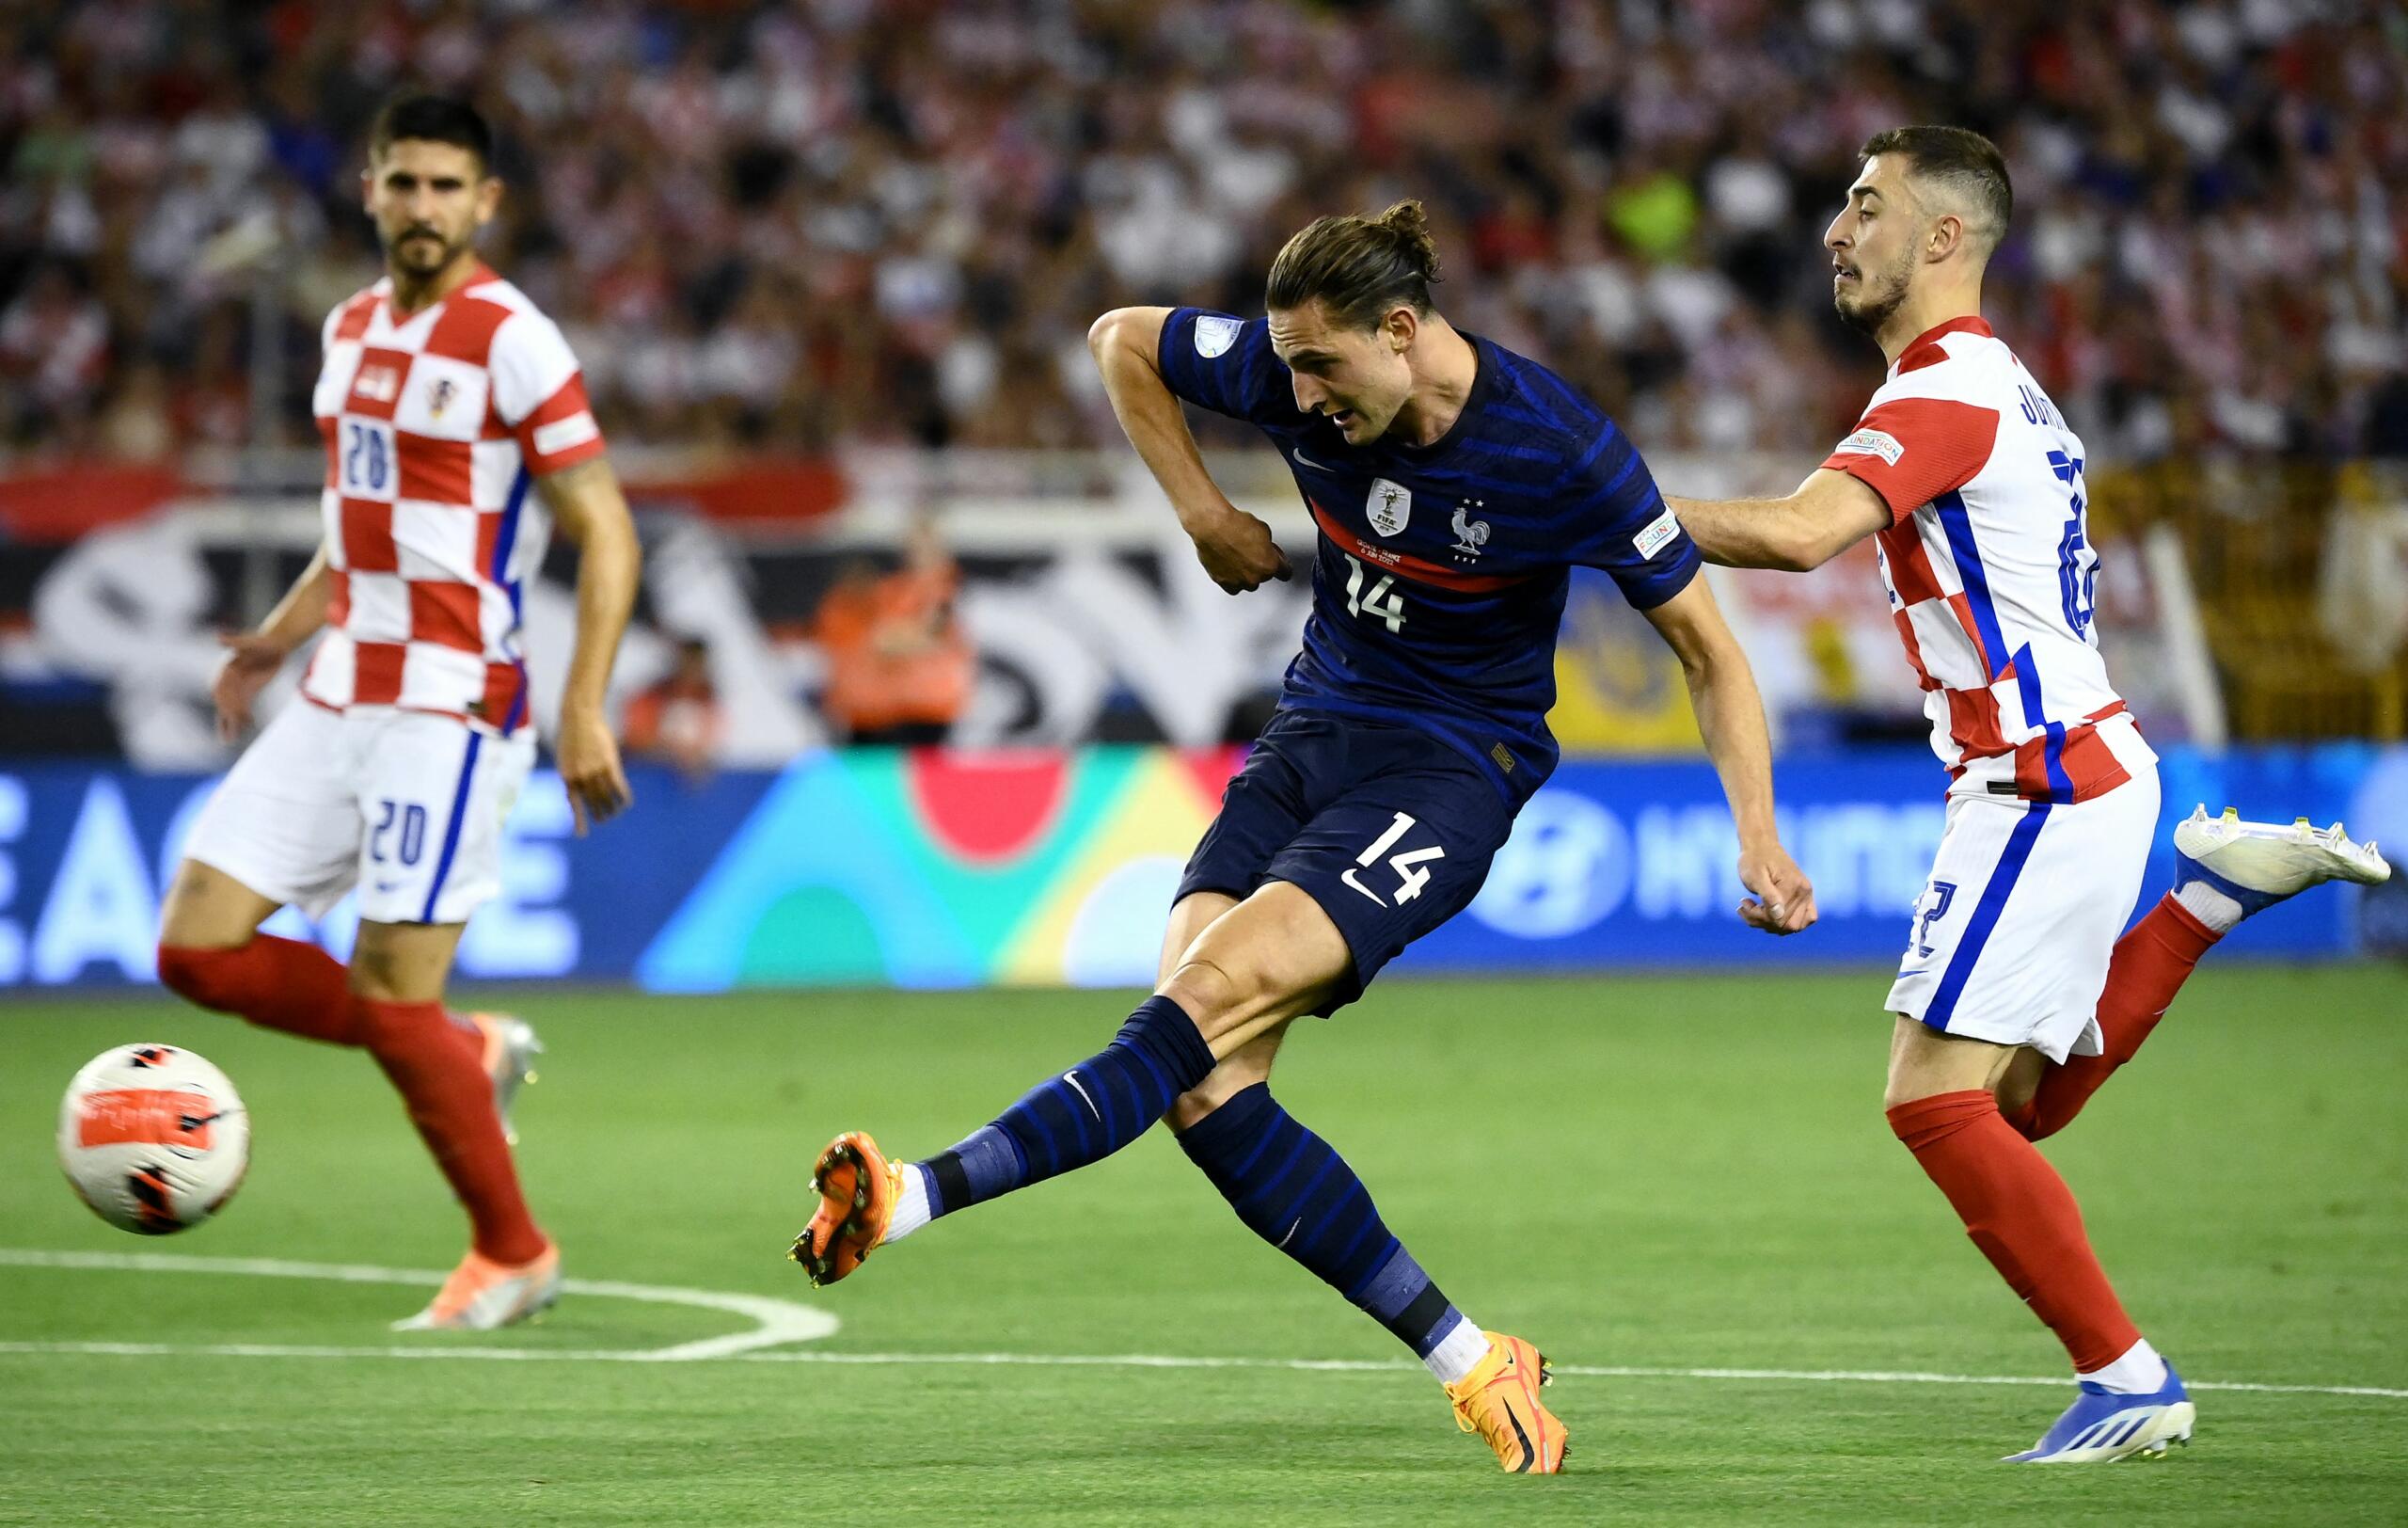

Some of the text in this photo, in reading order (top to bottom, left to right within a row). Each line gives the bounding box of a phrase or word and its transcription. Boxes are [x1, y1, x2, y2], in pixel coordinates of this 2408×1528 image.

[1845, 436, 1899, 458] UNDATION
[1377, 513, 1394, 526] FIFA
[1344, 552, 1407, 634] 14
[372, 800, 426, 867] 20
[1355, 811, 1446, 906] 14
